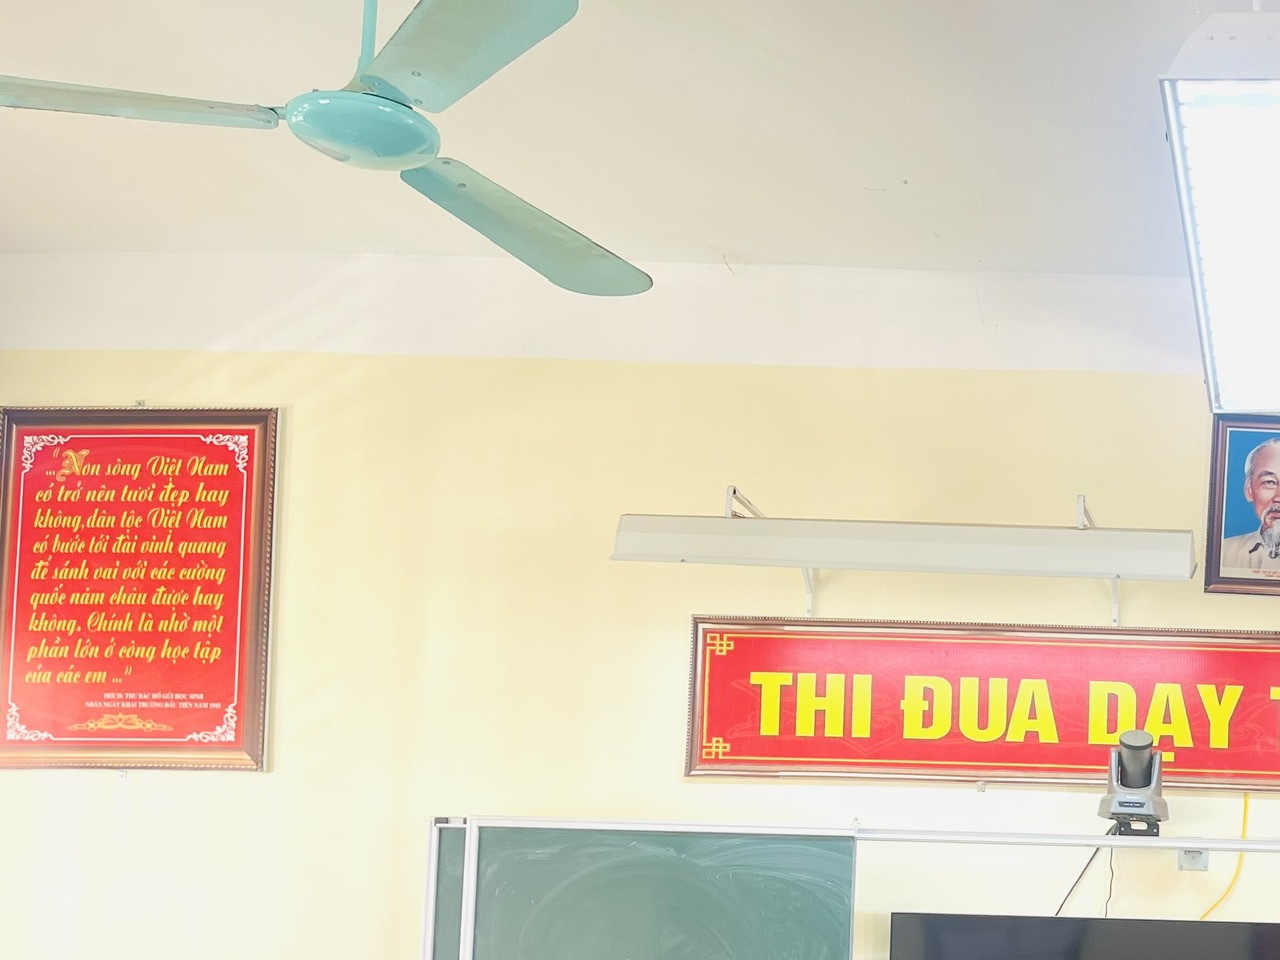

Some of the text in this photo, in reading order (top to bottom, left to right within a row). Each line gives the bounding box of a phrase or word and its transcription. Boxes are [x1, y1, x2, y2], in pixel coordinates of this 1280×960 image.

[105, 459, 141, 480] sông
[147, 456, 182, 481] Việt
[187, 456, 229, 476] Nam
[35, 482, 55, 502] có
[86, 486, 115, 502] nên
[121, 483, 156, 502] tươi
[159, 483, 190, 507] đẹp
[195, 482, 229, 506] hay
[87, 508, 116, 528] dân
[121, 508, 142, 533] tộc
[147, 507, 182, 533] Việt
[186, 508, 228, 528] Nam
[33, 532, 226, 558] có bước tới đài vinh quang
[53, 560, 89, 580] sánh
[94, 561, 119, 580] vai
[122, 561, 148, 580] với
[150, 561, 176, 580] các
[179, 560, 226, 585] cường
[30, 584, 224, 611] quốc năm châu được hay
[28, 611, 224, 637] không. Chính là nhờ một
[27, 637, 69, 662] phần
[74, 638, 100, 658] lớn
[118, 640, 157, 663] công
[161, 639, 190, 664] học
[193, 641, 221, 664] tập
[56, 665, 81, 683] các
[85, 670, 106, 683] em
[749, 671, 873, 738] THI
[900, 674, 1060, 743] ĐUA
[1087, 680, 1245, 762] DẠY
